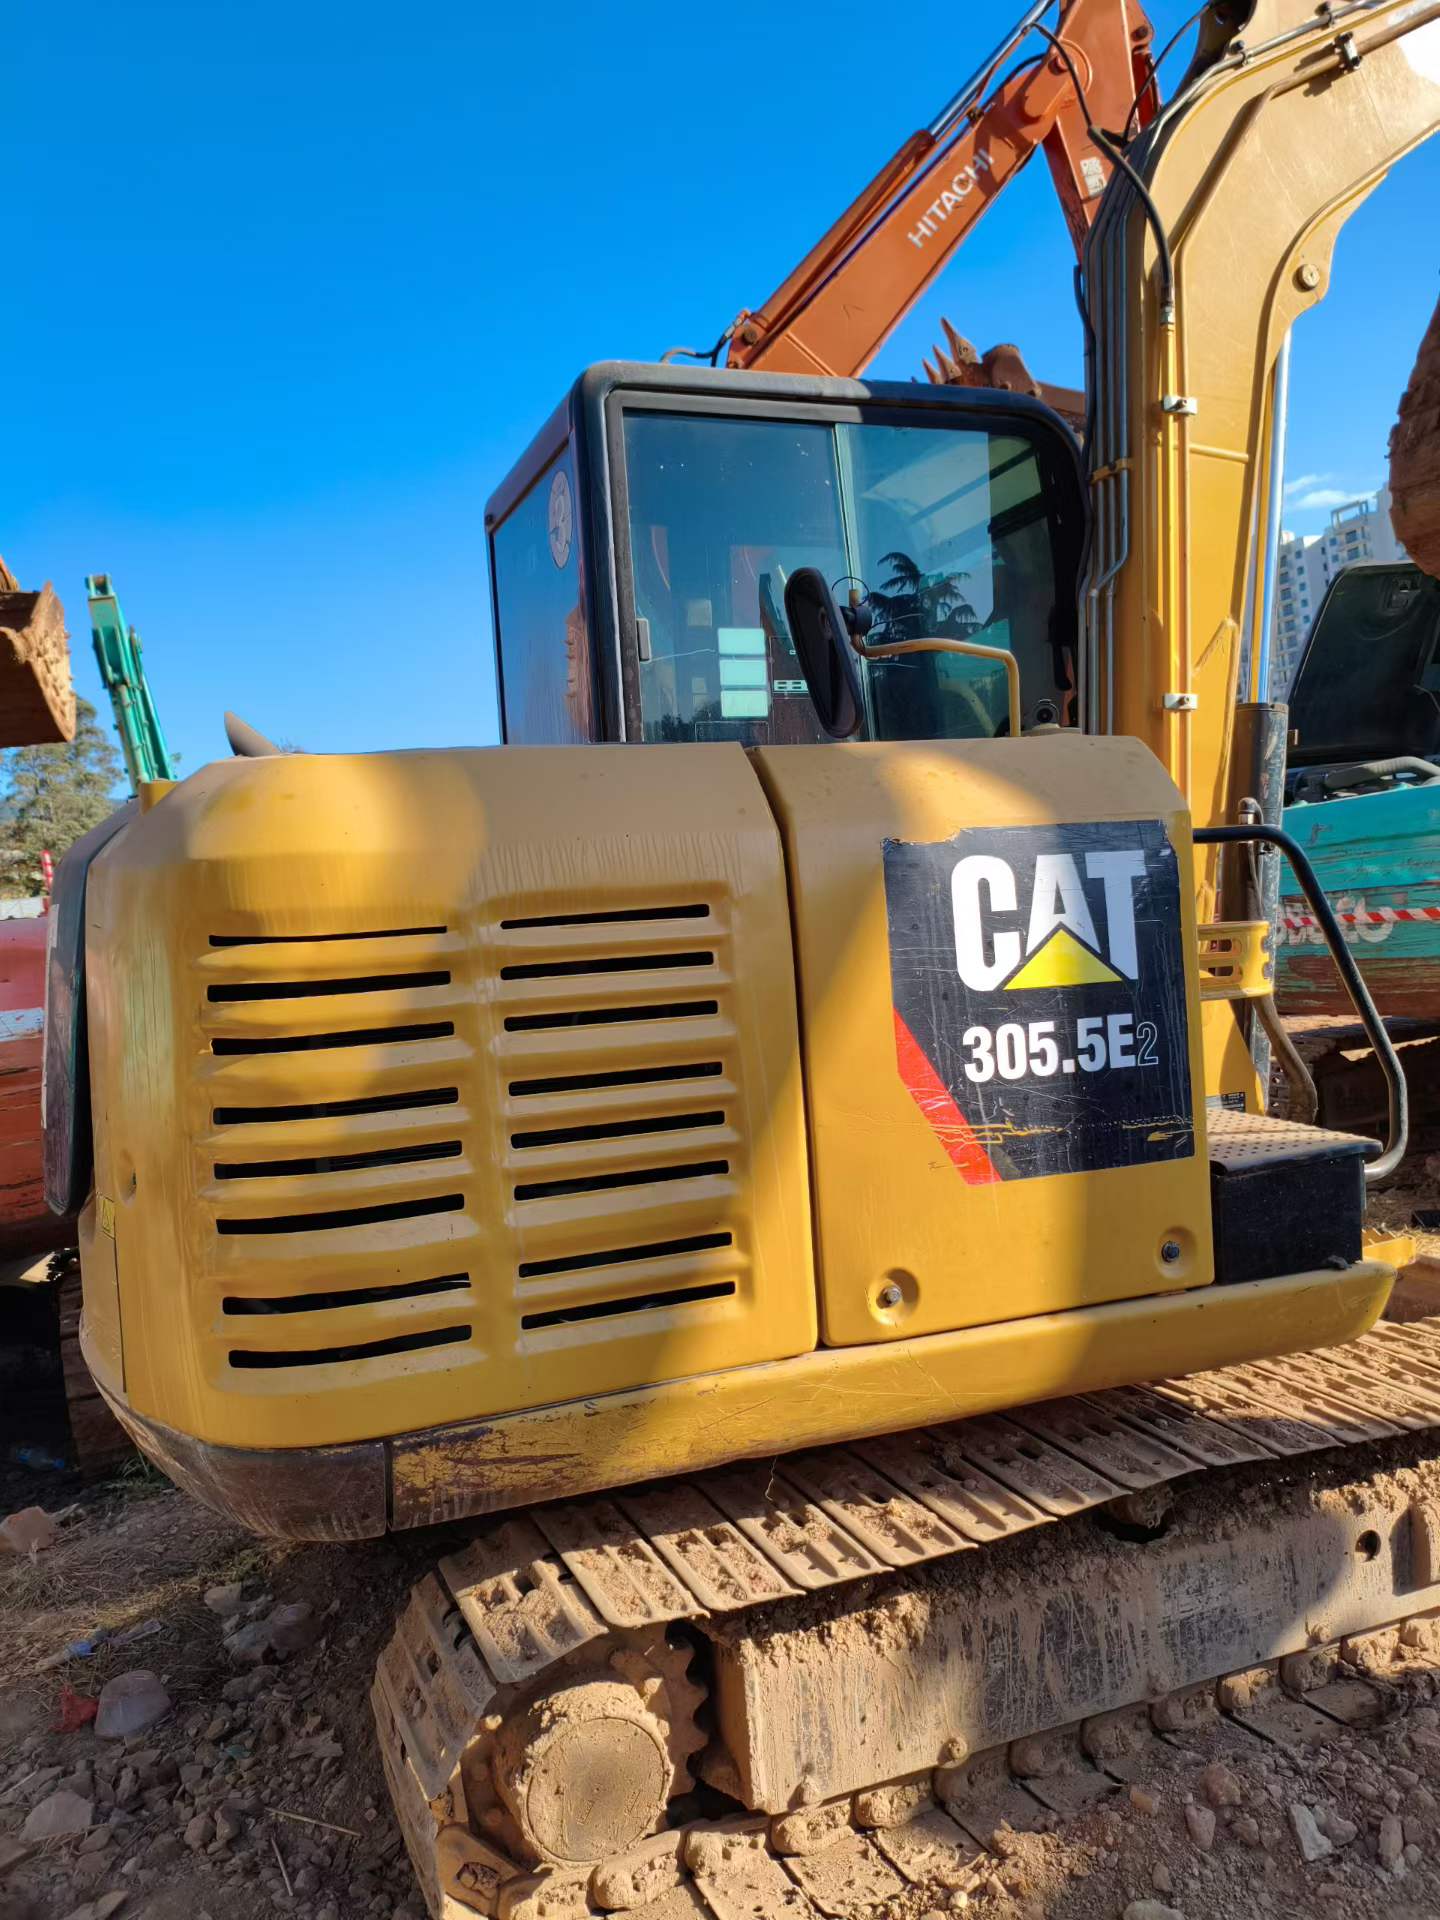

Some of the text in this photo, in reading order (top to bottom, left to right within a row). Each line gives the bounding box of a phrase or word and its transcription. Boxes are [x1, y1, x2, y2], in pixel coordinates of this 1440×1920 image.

[907, 148, 994, 248] HITACHI
[951, 850, 1146, 992] CAT
[962, 1013, 1159, 1083] 305.5E2
